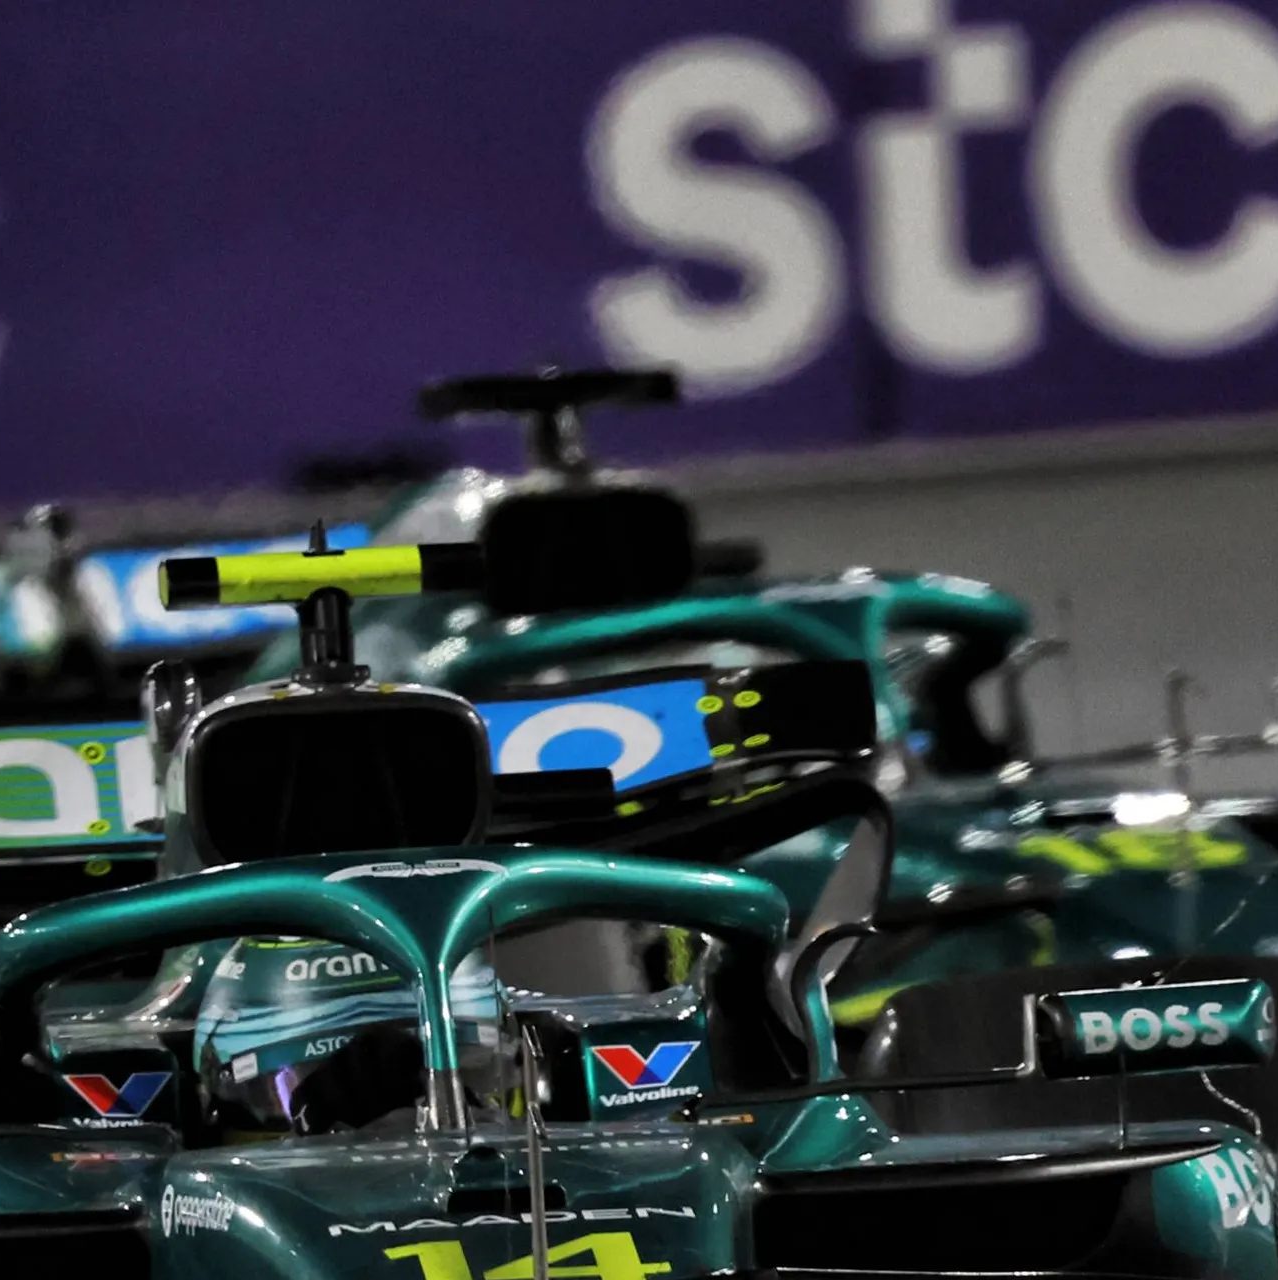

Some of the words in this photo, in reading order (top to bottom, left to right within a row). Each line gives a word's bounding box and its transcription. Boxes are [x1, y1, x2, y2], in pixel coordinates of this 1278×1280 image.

[1079, 1002, 1230, 1054] BOSS
[599, 1085, 700, 1108] Valvoline
[328, 1205, 696, 1238] MAADEN
